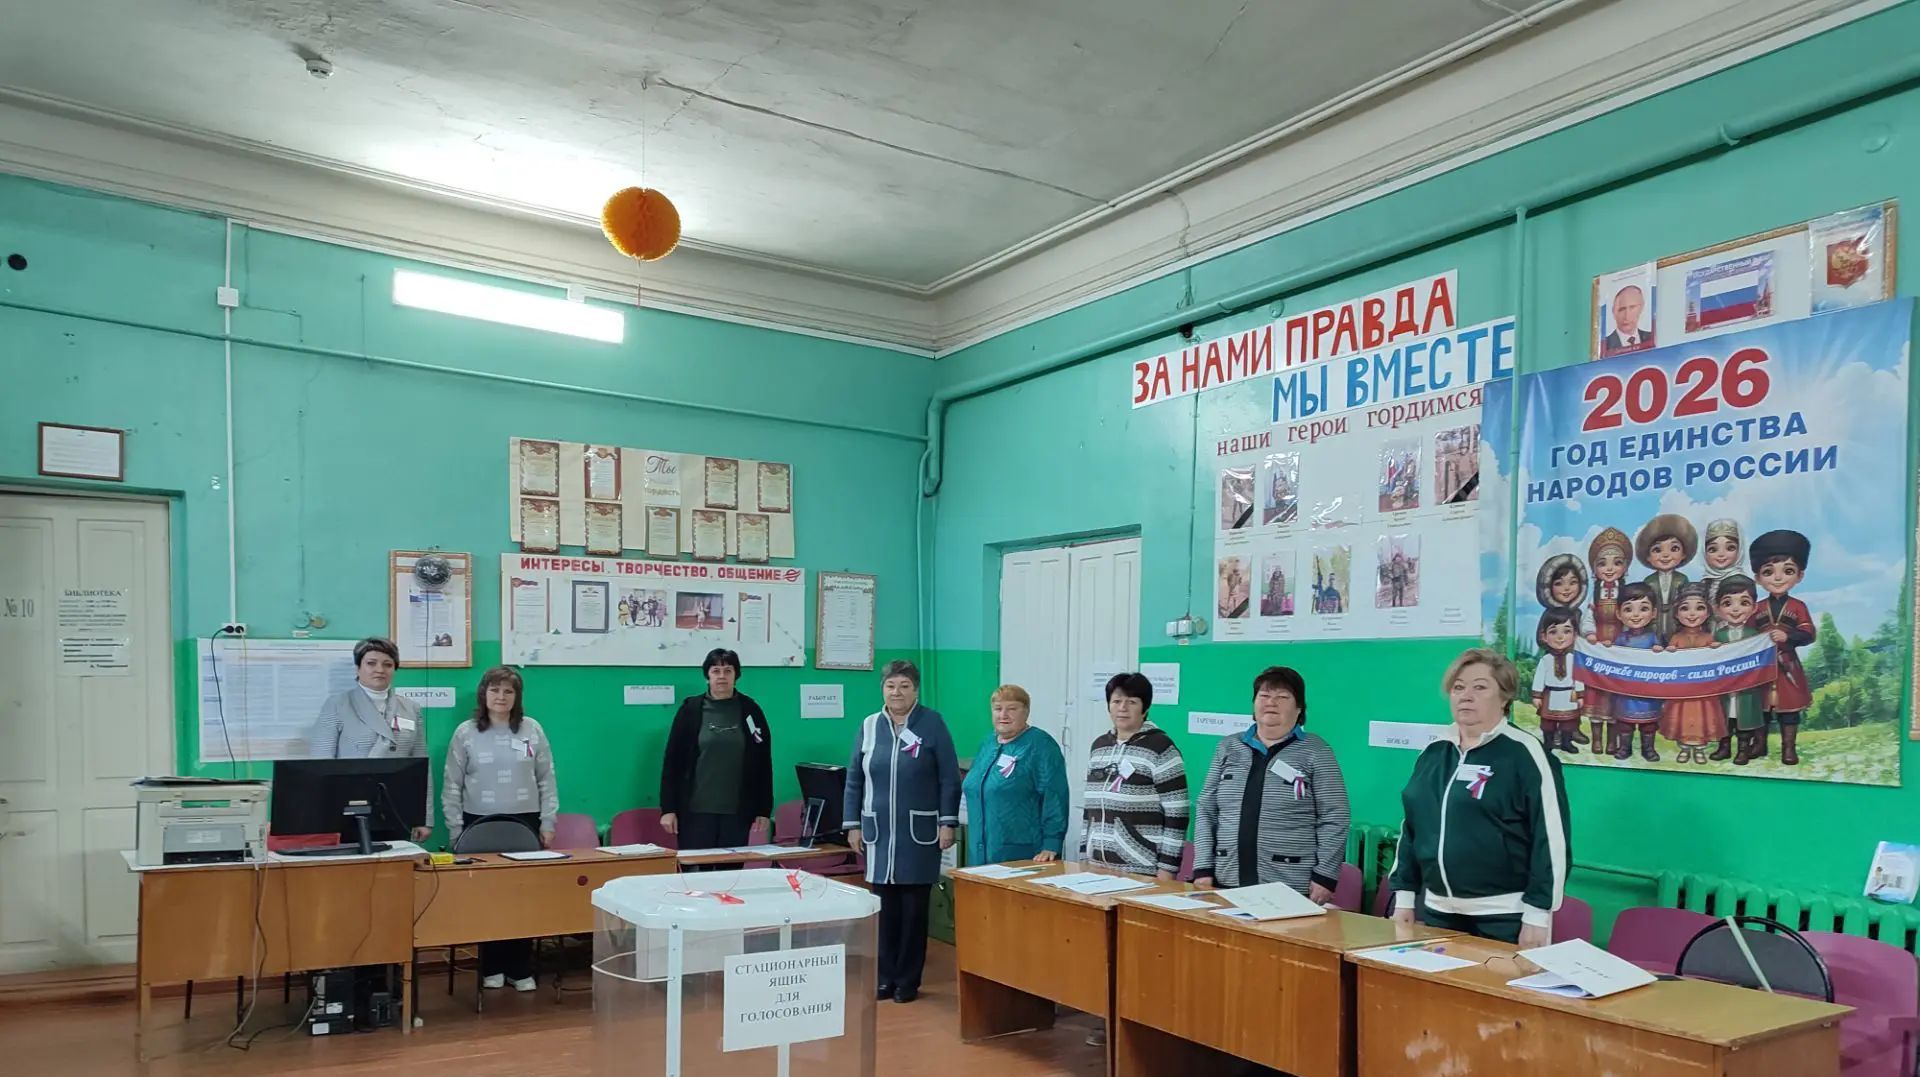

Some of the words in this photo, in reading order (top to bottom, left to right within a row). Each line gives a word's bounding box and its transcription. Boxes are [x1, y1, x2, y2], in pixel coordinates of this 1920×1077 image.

[1134, 356, 1172, 405] ЗА
[1181, 325, 1272, 393] НАМИ
[1285, 277, 1455, 367] ПРАВДА
[1271, 364, 1328, 423] МЫ
[1346, 321, 1515, 408] ВМЕСТЕ
[1581, 348, 1770, 432] 2026
[1216, 431, 1271, 456] наши
[1287, 416, 1348, 444] герои
[1366, 387, 1483, 429] гордимся
[1551, 440, 1609, 469] ГОД
[1619, 411, 1808, 461] ЕДИНСТВА
[1527, 465, 1673, 503] НАРОДОВ
[1685, 444, 1839, 486] РОССИИ
[717, 566, 782, 582] ОБЩЕНИЕ
[21, 598, 34, 617] 10
[1584, 656, 1592, 666] В
[1593, 660, 1632, 678] дружбе
[1633, 669, 1678, 683] народов
[1687, 669, 1715, 680] сила
[1717, 656, 1760, 676] России!
[735, 953, 838, 975] СТАЦИОНАРНЫЙ
[769, 974, 807, 987] ЯЩИК
[775, 991, 801, 1004] ДЛЯ
[741, 1002, 832, 1023] ГОЛОСОВАНИЯ
